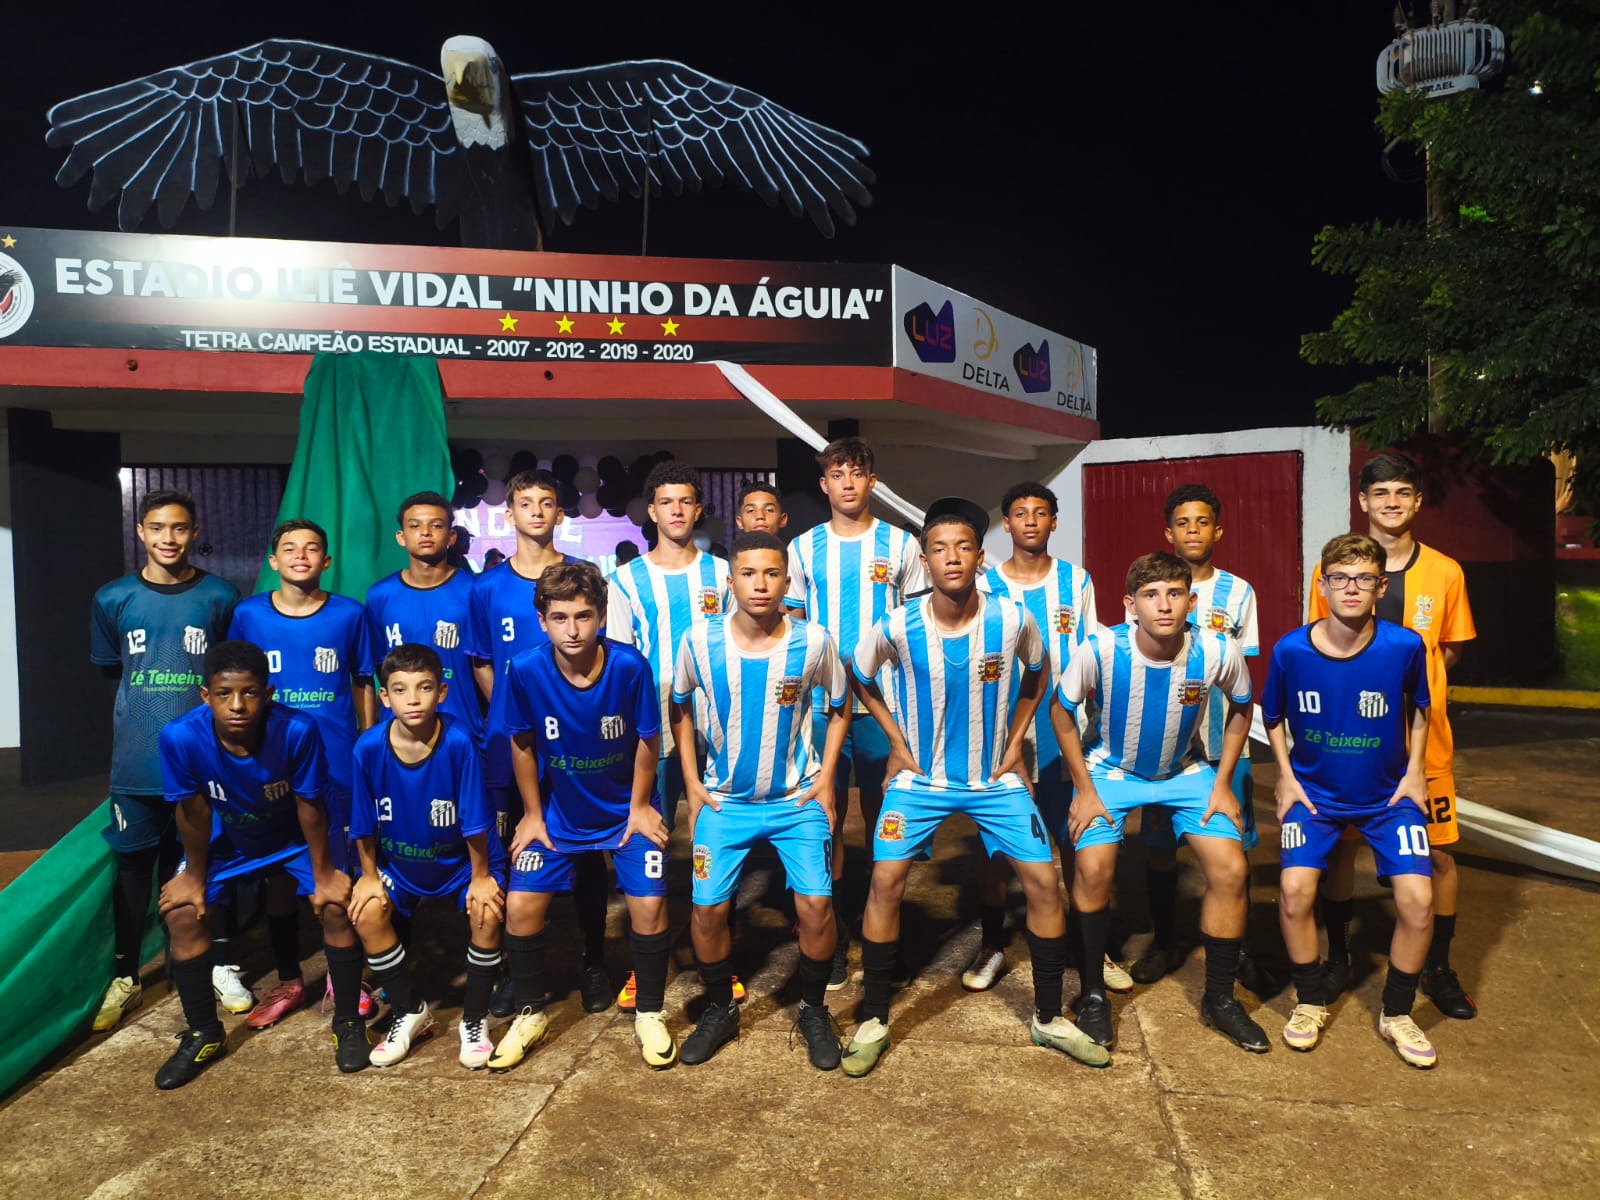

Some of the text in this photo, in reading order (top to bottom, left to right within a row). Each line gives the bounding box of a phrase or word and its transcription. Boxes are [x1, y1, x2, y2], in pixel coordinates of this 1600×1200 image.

[55, 257, 263, 300] ESTADIO
[277, 260, 359, 305] ILIÊ
[368, 271, 502, 310] VIDAL
[684, 283, 739, 317] DA
[180, 330, 254, 349] TETRA
[258, 330, 363, 353] CAMPEÃO
[368, 335, 471, 356] ESTADUAL
[487, 339, 530, 357] 2007
[546, 341, 585, 359] 2012
[600, 342, 638, 360] 2019
[653, 344, 694, 361] 2020
[911, 314, 953, 351] LUZ
[962, 362, 1010, 393] DELTA
[1018, 353, 1049, 382] LUZ
[1056, 391, 1093, 413] DELTA
[127, 628, 146, 655] 12
[385, 622, 403, 648] 14
[501, 617, 515, 642] 3
[264, 650, 282, 674] 0
[129, 668, 204, 686] Zé Teixeira
[282, 688, 335, 703] Teixeira
[1297, 690, 1321, 714] 10
[544, 716, 560, 740] 8
[1304, 728, 1381, 748] Zé Teixeira
[549, 752, 625, 770] Zé Teixeira
[207, 780, 227, 801] 11
[1424, 796, 1452, 824] 12
[1030, 813, 1047, 845] 4
[1396, 825, 1430, 857] 10
[644, 850, 663, 879] 8
